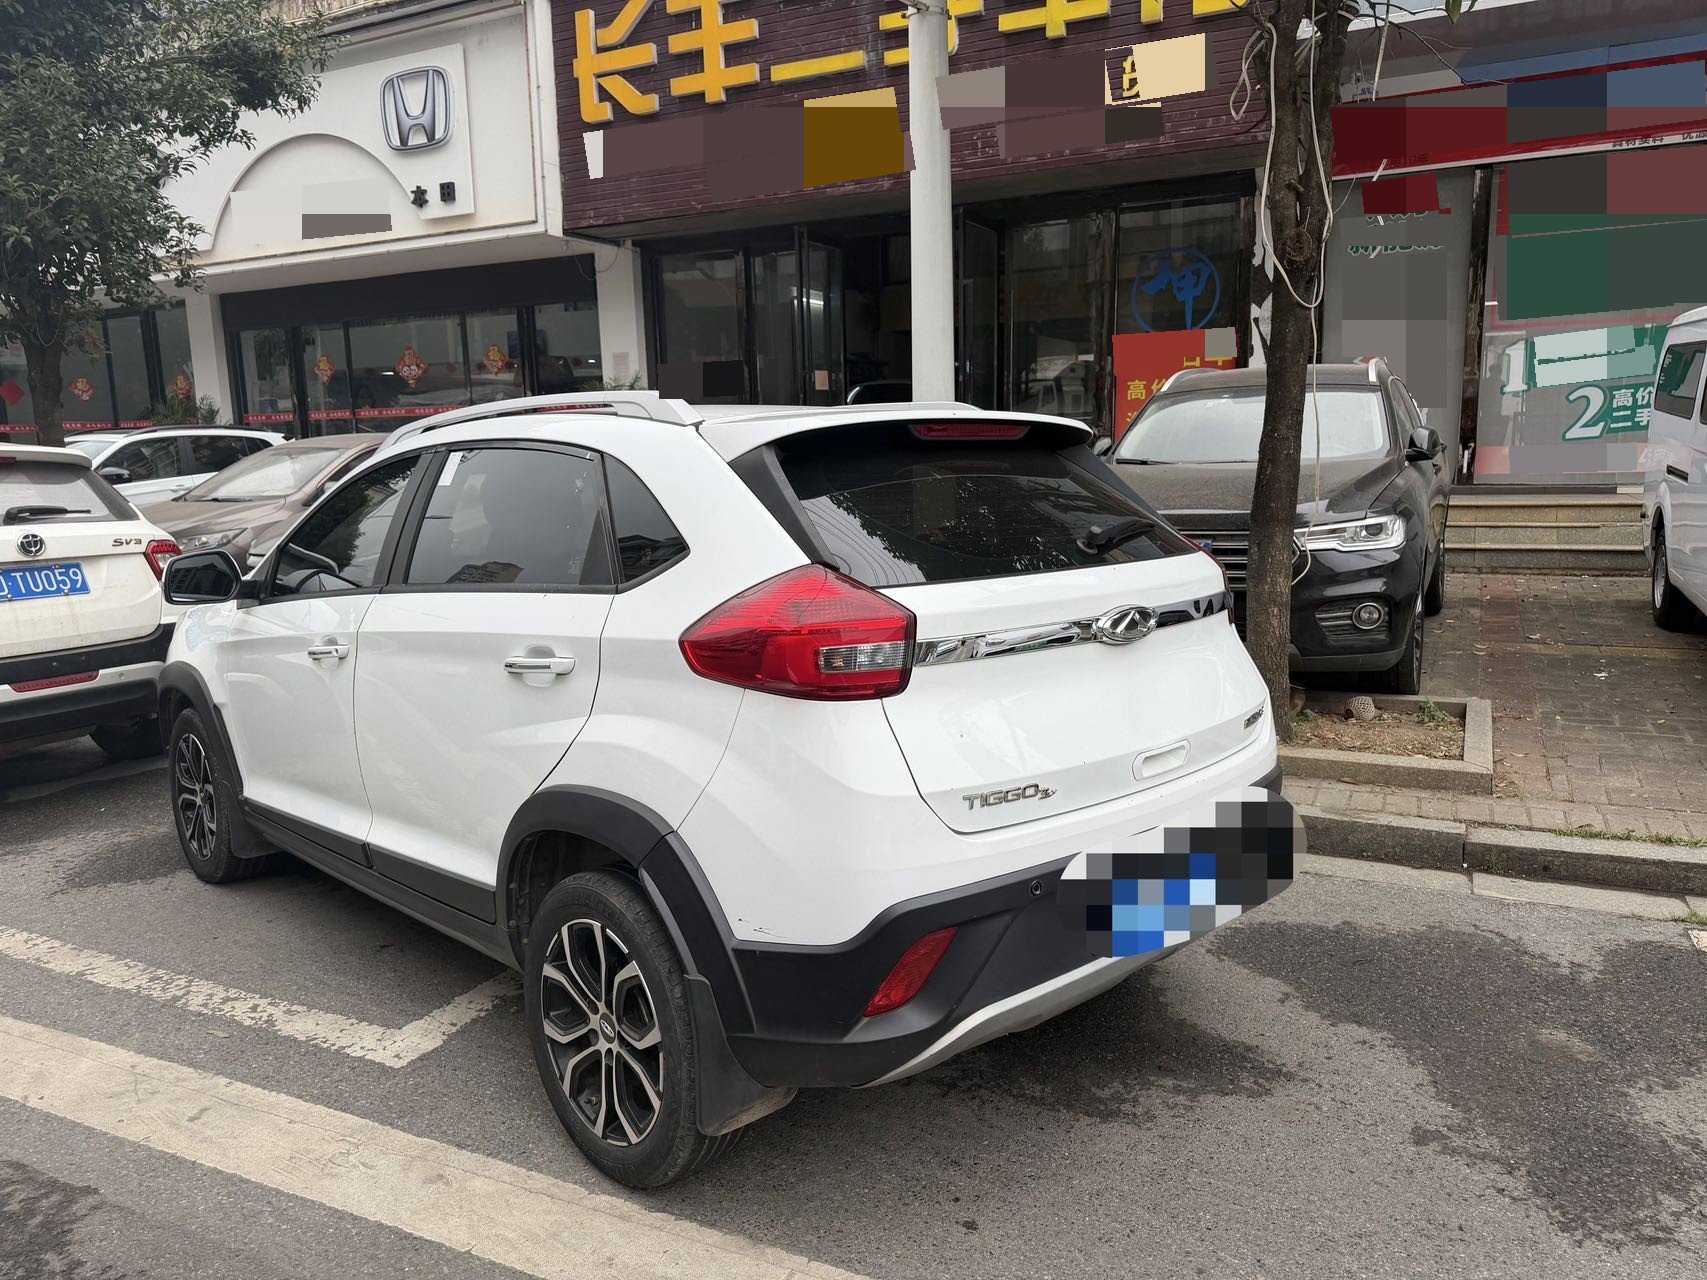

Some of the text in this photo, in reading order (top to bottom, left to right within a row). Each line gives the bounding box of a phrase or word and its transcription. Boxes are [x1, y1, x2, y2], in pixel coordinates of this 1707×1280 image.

[410, 181, 456, 208] 本田
[1564, 383, 1606, 441] 2
[111, 538, 143, 547] SV3
